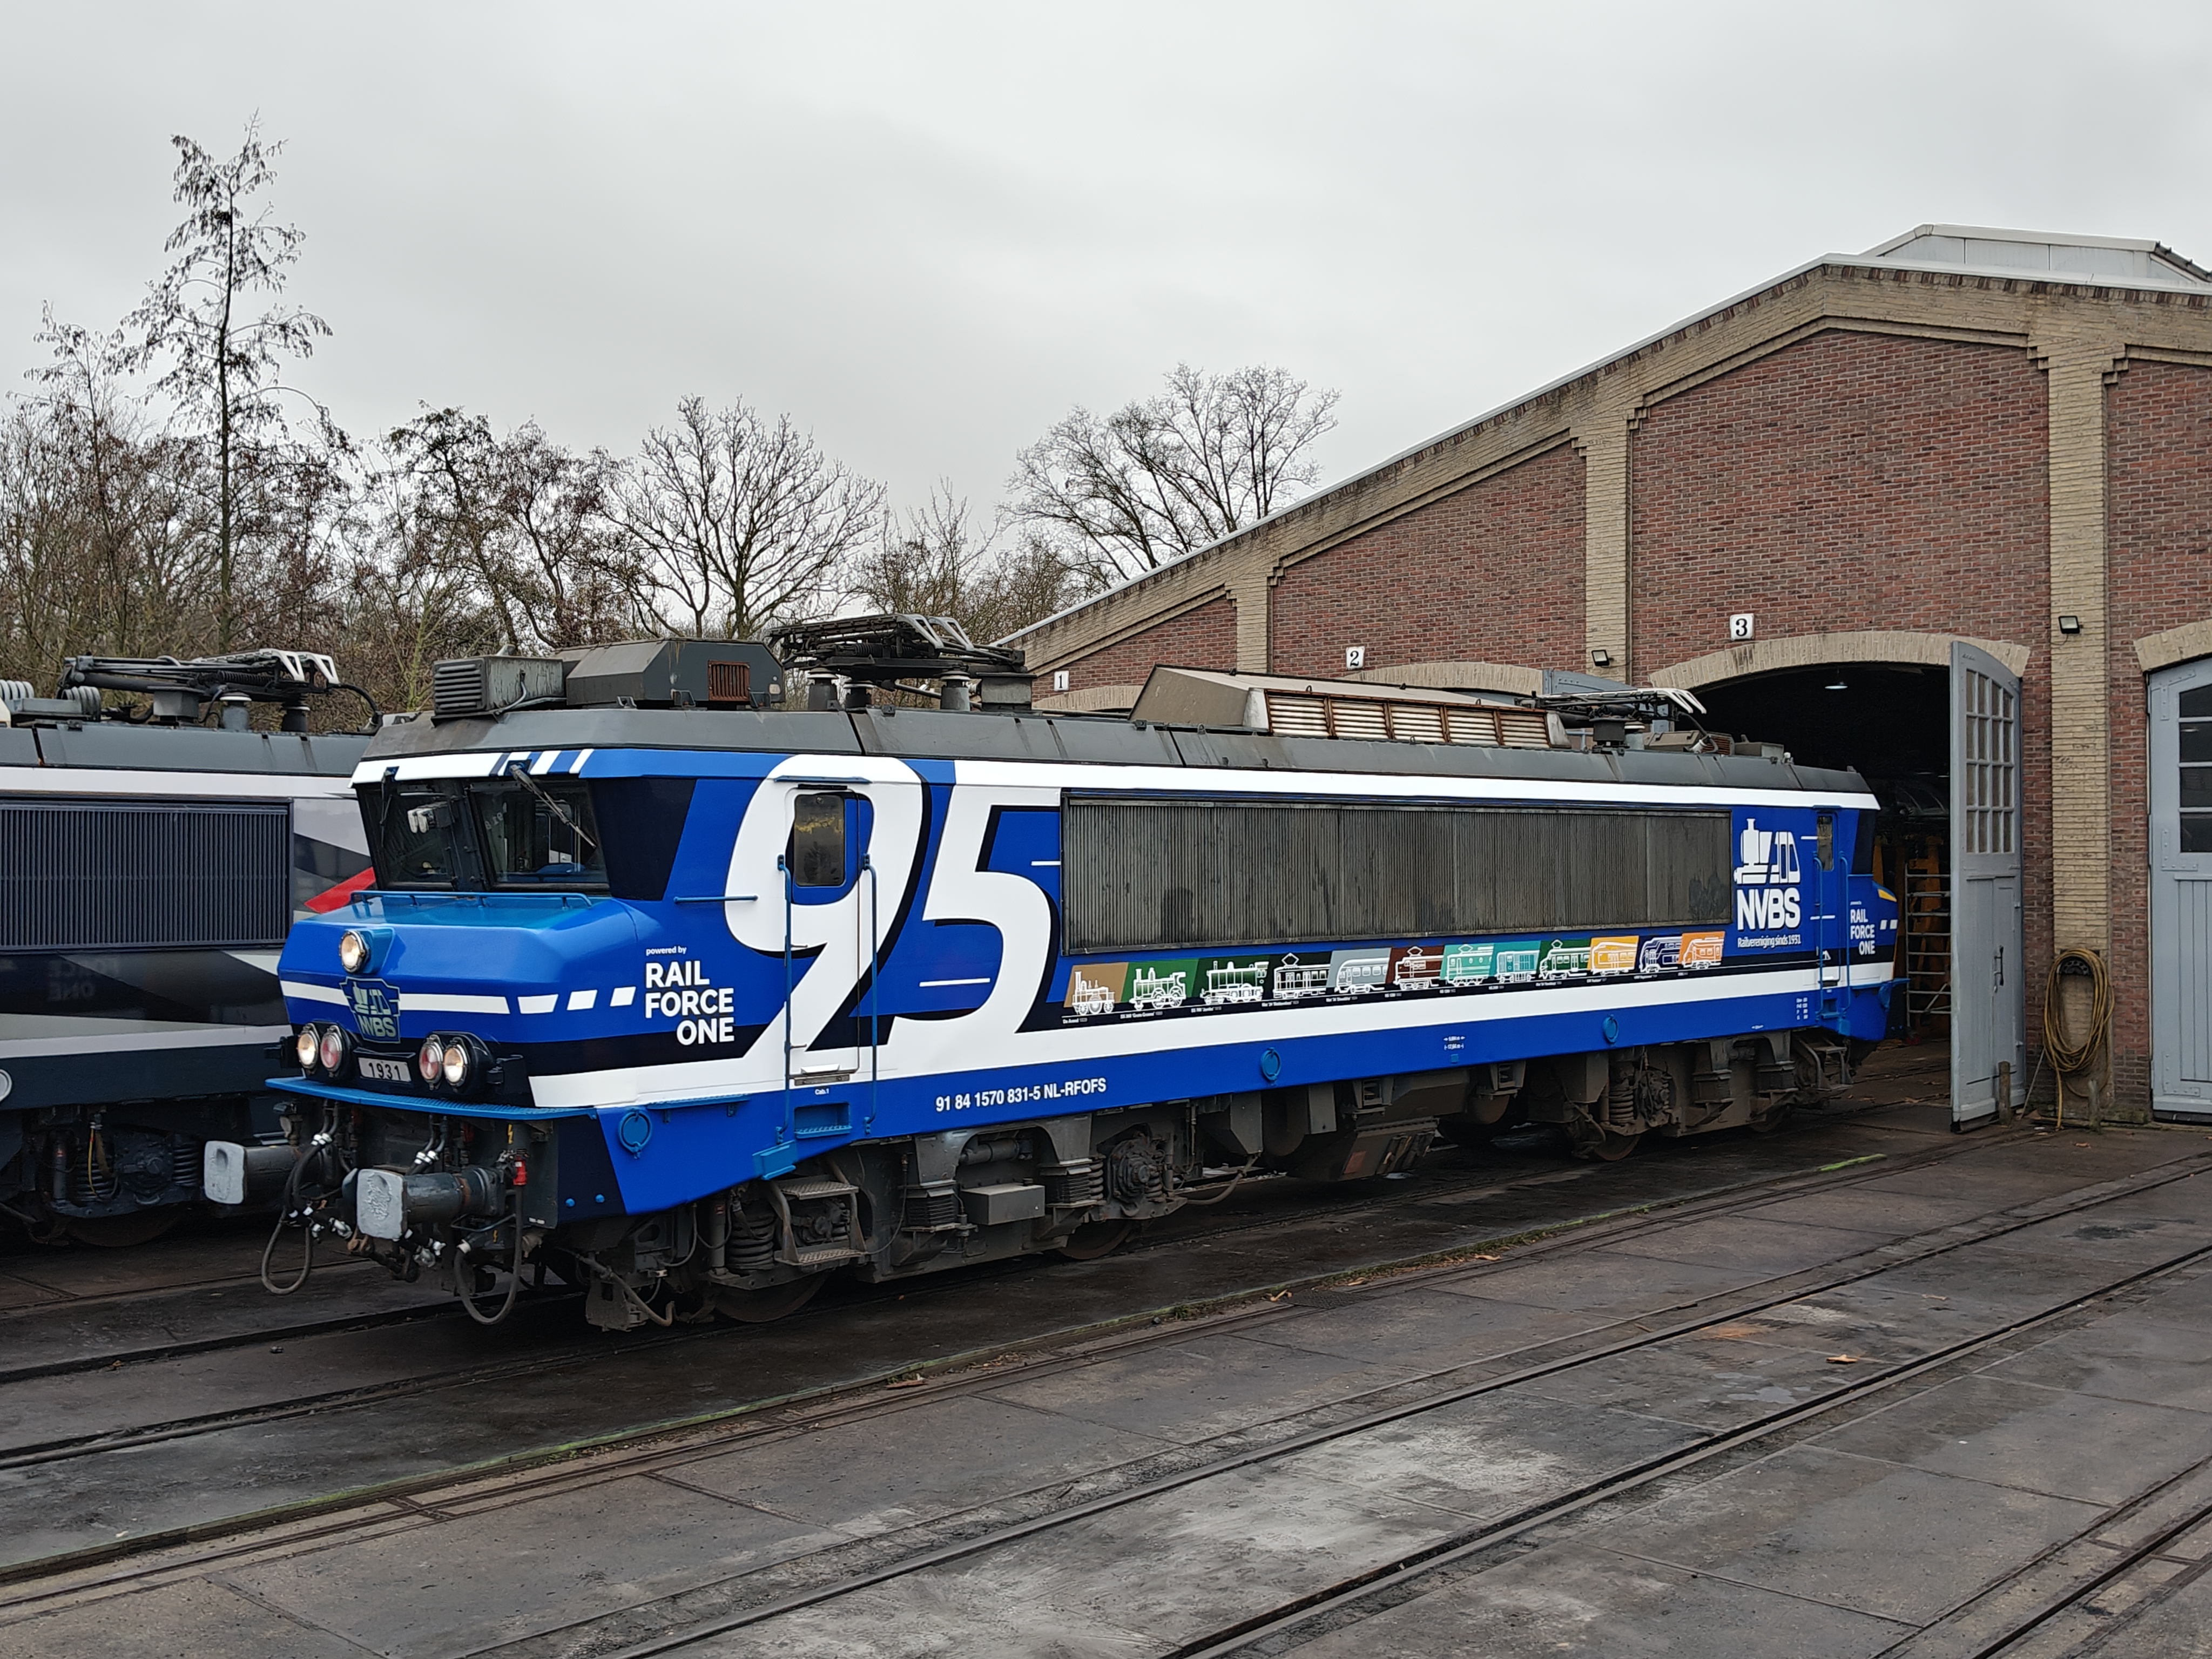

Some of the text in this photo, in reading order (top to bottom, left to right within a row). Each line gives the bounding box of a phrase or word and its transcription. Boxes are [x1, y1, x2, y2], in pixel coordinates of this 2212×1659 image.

[1736, 618, 1748, 637] 3
[1350, 651, 1359, 666] 2
[1058, 673, 1063, 689] 1
[725, 754, 1061, 1056] 95
[1737, 887, 1800, 930] NVBS
[1850, 908, 1869, 923] RAIL
[1788, 934, 1802, 945] 1931
[1850, 924, 1875, 940] FORCE
[646, 946, 687, 956] powered by
[1859, 940, 1876, 955] ONE
[646, 960, 710, 988] RAIL
[645, 988, 734, 1019] FORCE
[358, 1015, 396, 1037] NVBS
[677, 1017, 734, 1046] ONE
[369, 1062, 401, 1080] 1931
[935, 1077, 1107, 1112] 91 84 1570 831-5 NL-RFOFS
